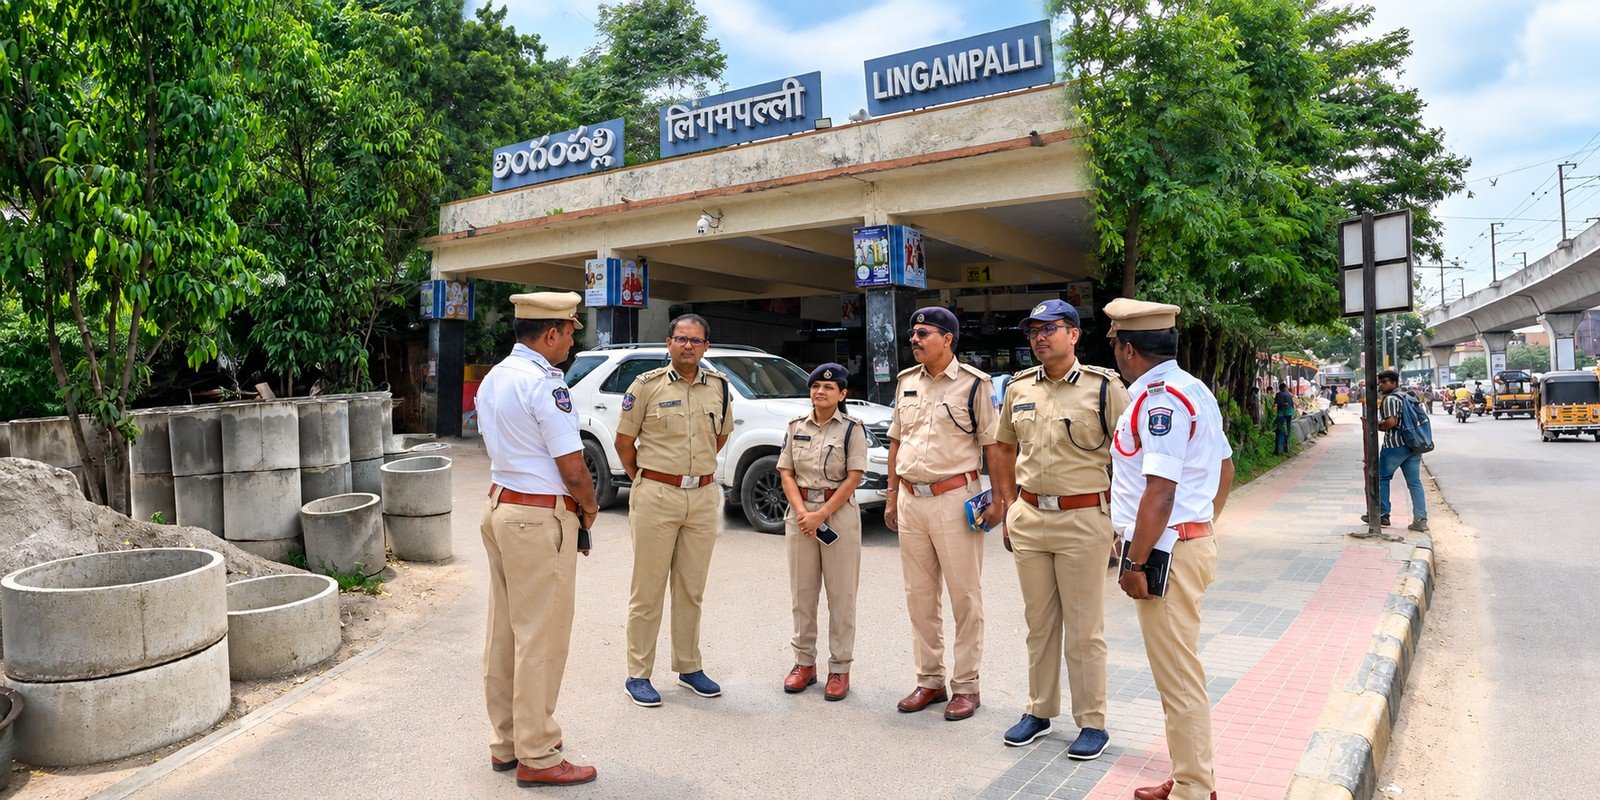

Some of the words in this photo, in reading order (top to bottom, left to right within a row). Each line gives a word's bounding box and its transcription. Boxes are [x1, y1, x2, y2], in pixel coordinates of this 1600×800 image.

[873, 35, 1043, 100] LINGAMPALLI
[665, 77, 806, 143] लिंगमपल्ली
[492, 125, 616, 179] లింగంపల్లి
[982, 266, 991, 281] 1
